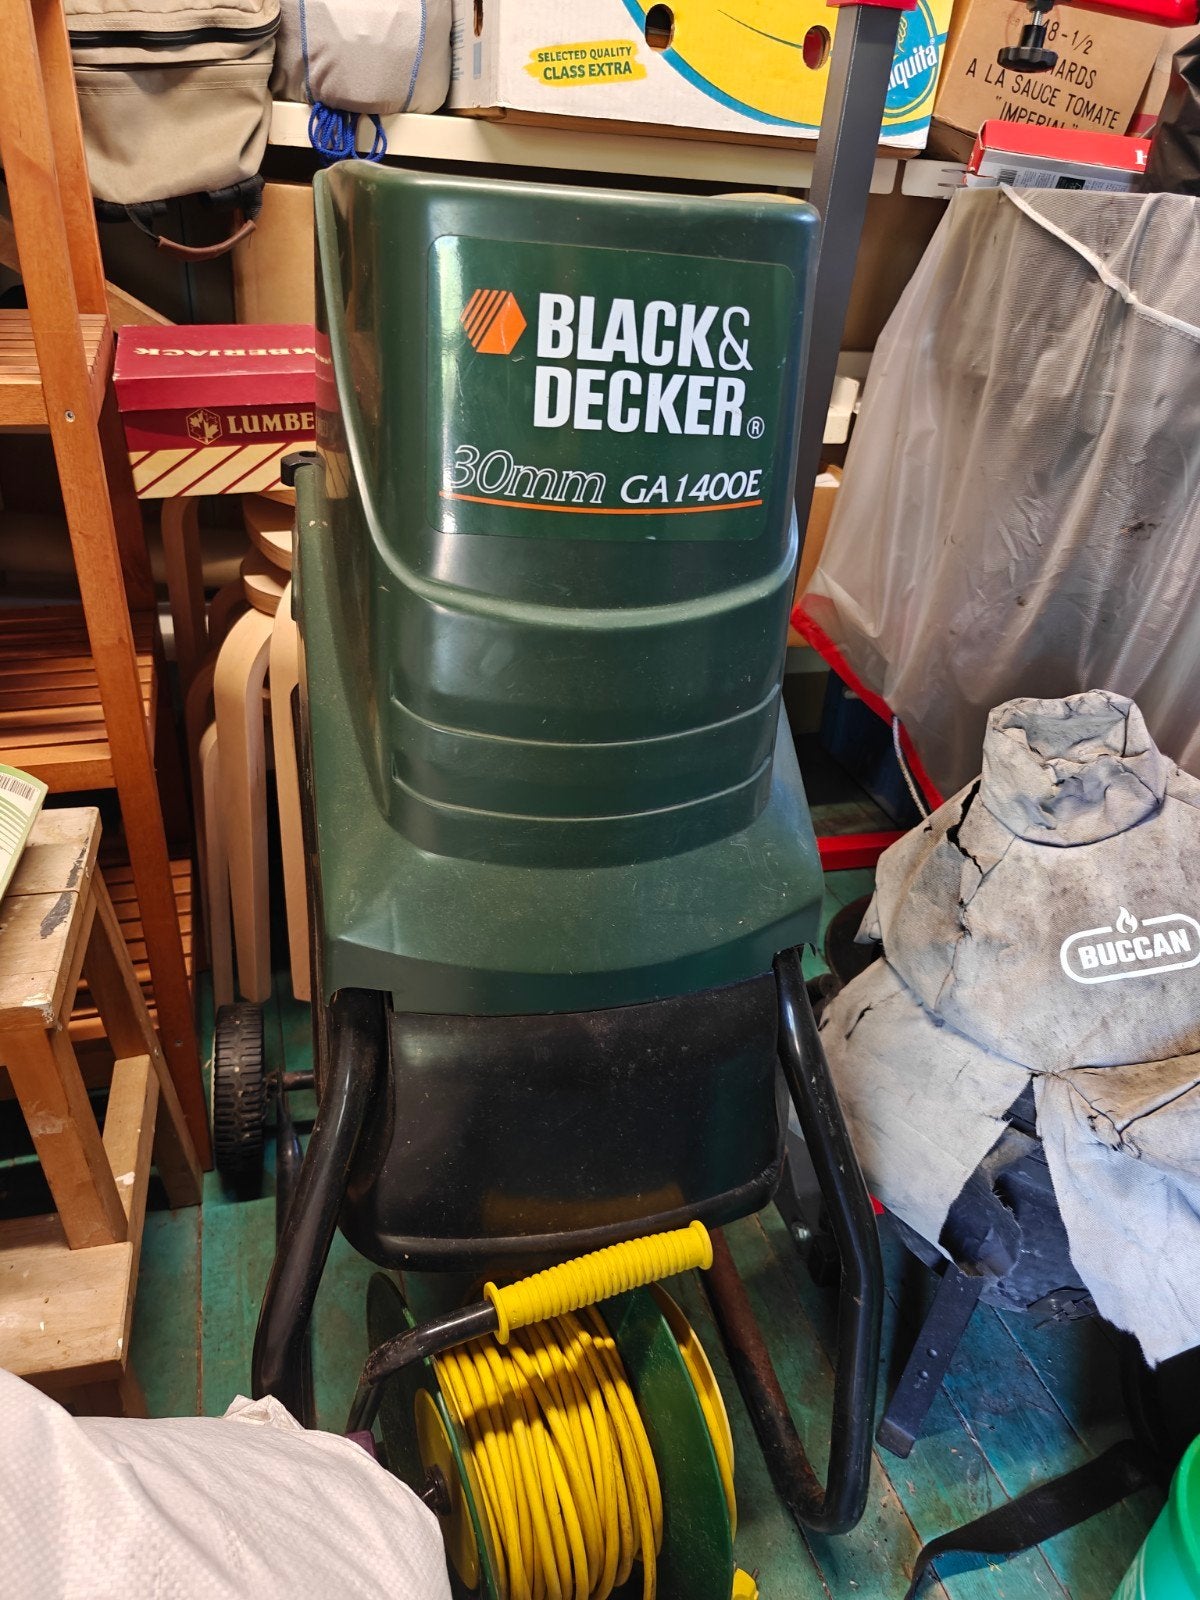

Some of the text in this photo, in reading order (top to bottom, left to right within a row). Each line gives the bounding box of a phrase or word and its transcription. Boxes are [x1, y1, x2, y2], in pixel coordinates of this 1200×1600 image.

[537, 46, 632, 62] SELECTED QUALITY
[543, 61, 633, 80] CLASS EXTRA
[1046, 58, 1097, 89] ARDS
[965, 58, 1121, 130] A LA SAUCE TOMATE
[450, 445, 607, 504] 30mm
[1077, 928, 1192, 970] BUCCAN
